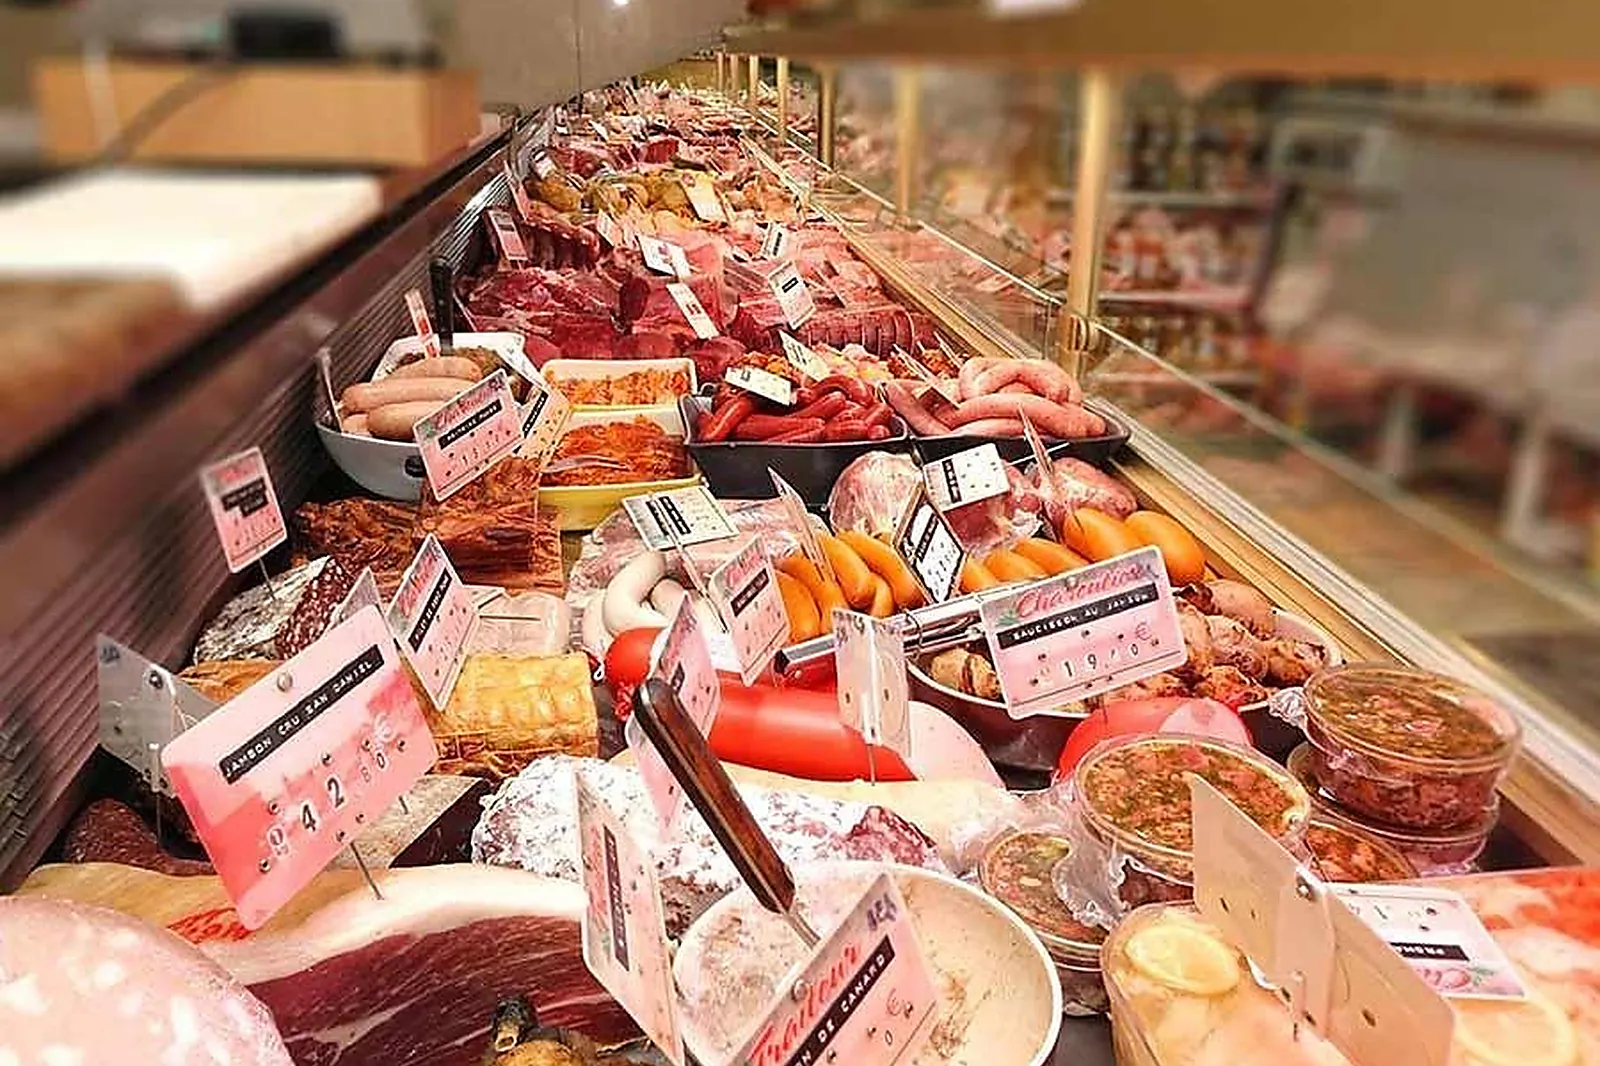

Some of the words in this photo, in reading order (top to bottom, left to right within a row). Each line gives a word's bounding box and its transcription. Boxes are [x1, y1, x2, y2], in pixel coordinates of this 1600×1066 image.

[1084, 608, 1099, 621] AU
[225, 737, 273, 778] JAMBON
[278, 716, 302, 737] CRU
[305, 693, 330, 714] SAN
[334, 660, 374, 692] DANIEL
[818, 1019, 835, 1044] DE
[840, 953, 886, 1013] CANARD
